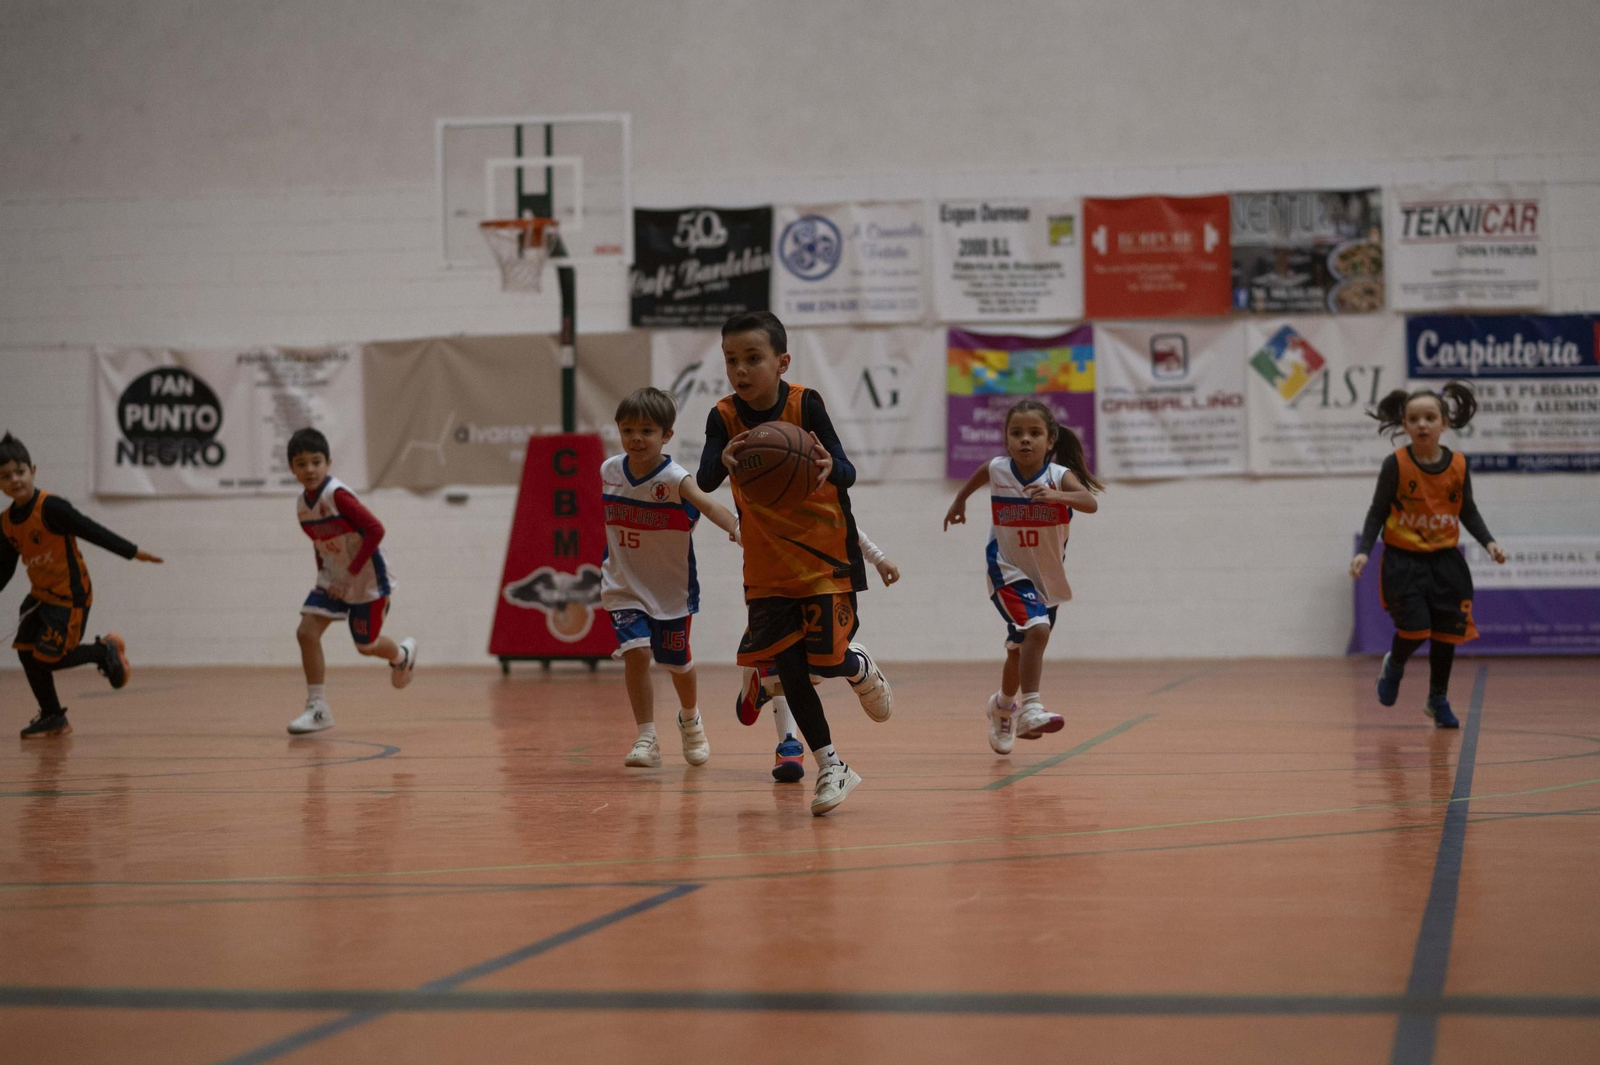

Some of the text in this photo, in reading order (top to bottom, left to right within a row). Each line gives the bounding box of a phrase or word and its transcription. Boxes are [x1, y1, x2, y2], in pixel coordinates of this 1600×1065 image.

[1401, 203, 1539, 236] TEKNICAR
[1416, 329, 1582, 375] Carpintería
[150, 374, 195, 398] PAN
[1518, 384, 1598, 397] PLEGADO
[124, 403, 219, 432] PUNTO
[115, 437, 227, 468] NEGRO
[1409, 480, 1417, 493] 9
[619, 530, 641, 549] 15
[1017, 530, 1039, 548] 10
[662, 630, 686, 651] 15
